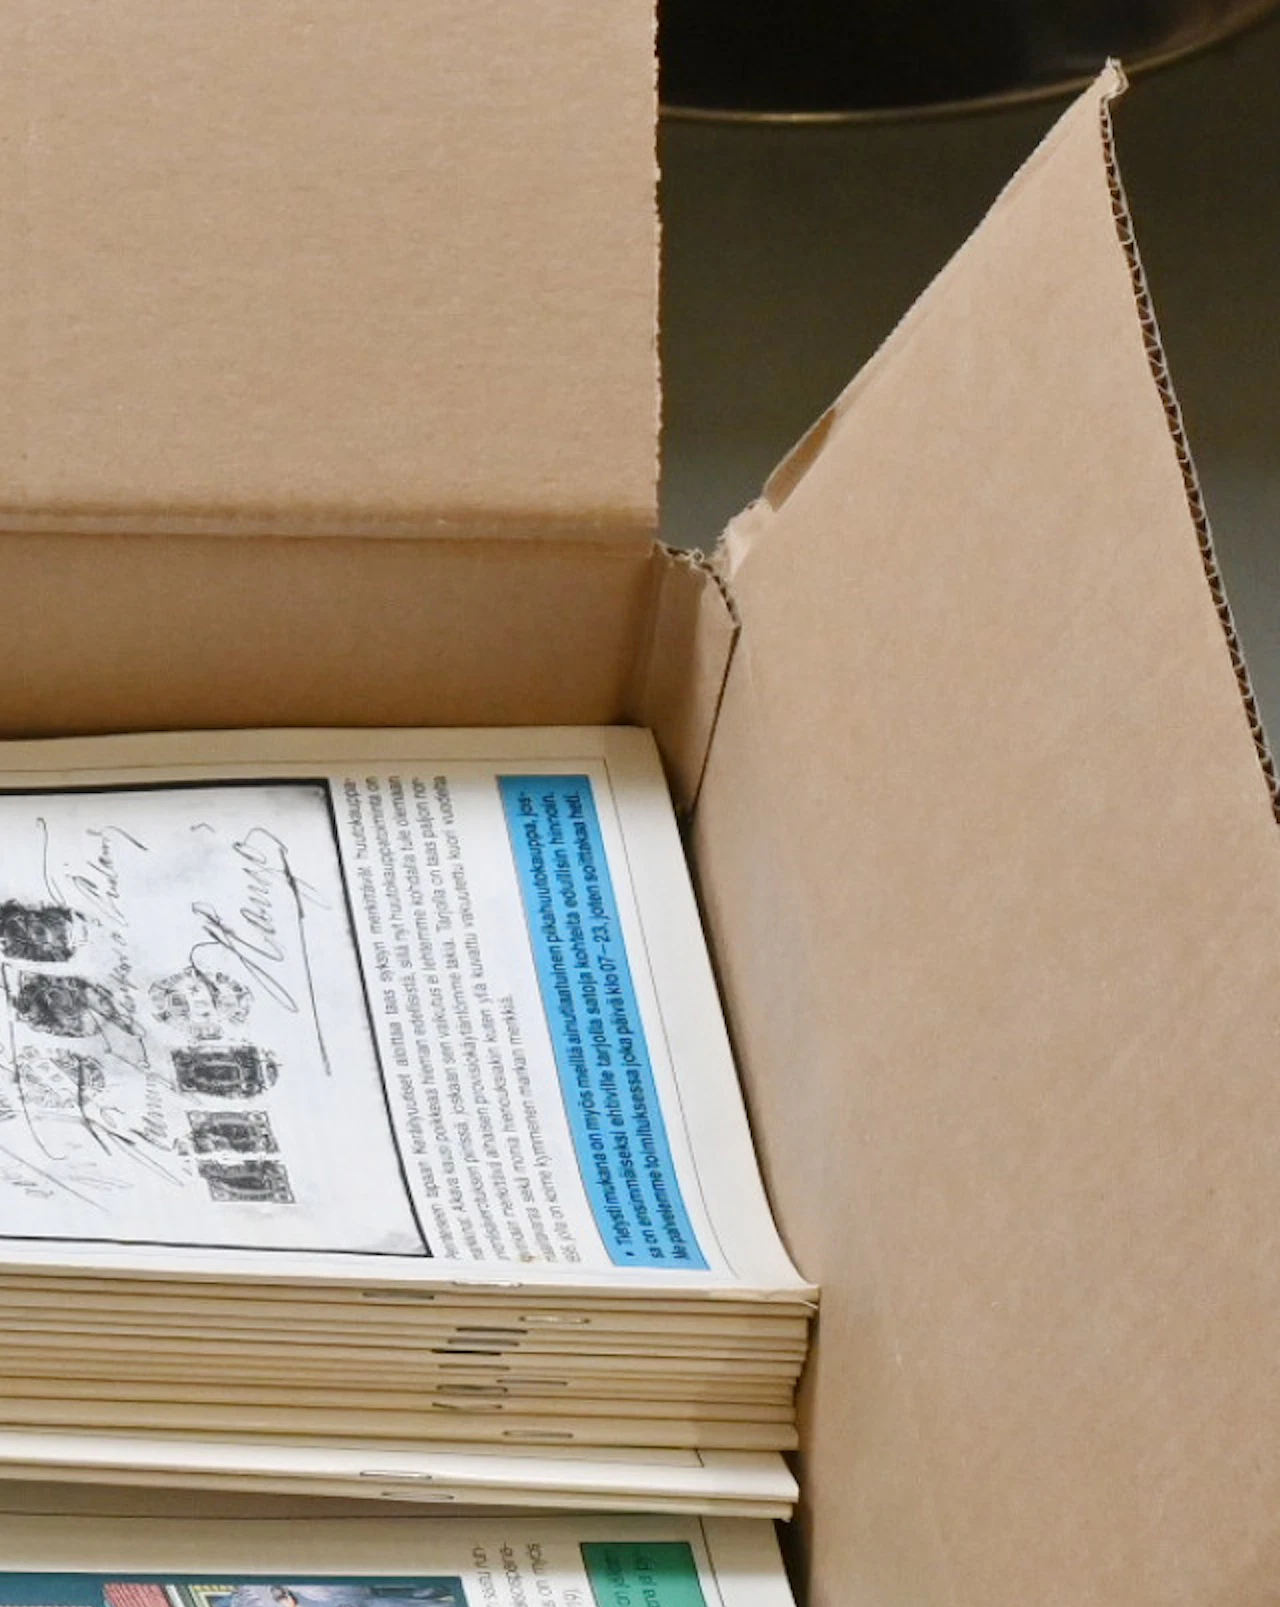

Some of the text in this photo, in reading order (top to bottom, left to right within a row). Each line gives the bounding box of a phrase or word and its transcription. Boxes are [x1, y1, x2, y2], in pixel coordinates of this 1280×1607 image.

[365, 777, 378, 792] on
[423, 842, 439, 866] taas
[573, 821, 598, 882] soittakaa
[428, 869, 442, 885] on
[521, 819, 564, 942] pikahuutokauppa,
[552, 849, 577, 908] edullisin
[588, 885, 610, 921] joten
[564, 912, 588, 968] kohteita
[373, 941, 395, 982] syksyn
[383, 989, 399, 1014] taas
[577, 972, 600, 1014] satoja
[603, 973, 622, 995] klo
[610, 997, 634, 1035] päivä
[585, 1018, 611, 1067] tarjolla
[618, 1038, 642, 1066] joka
[565, 1045, 590, 1088] meillä
[578, 1090, 601, 1130] myös
[597, 1070, 623, 1126] ehtiville
[589, 1133, 604, 1151] on
[643, 1229, 658, 1244] on
